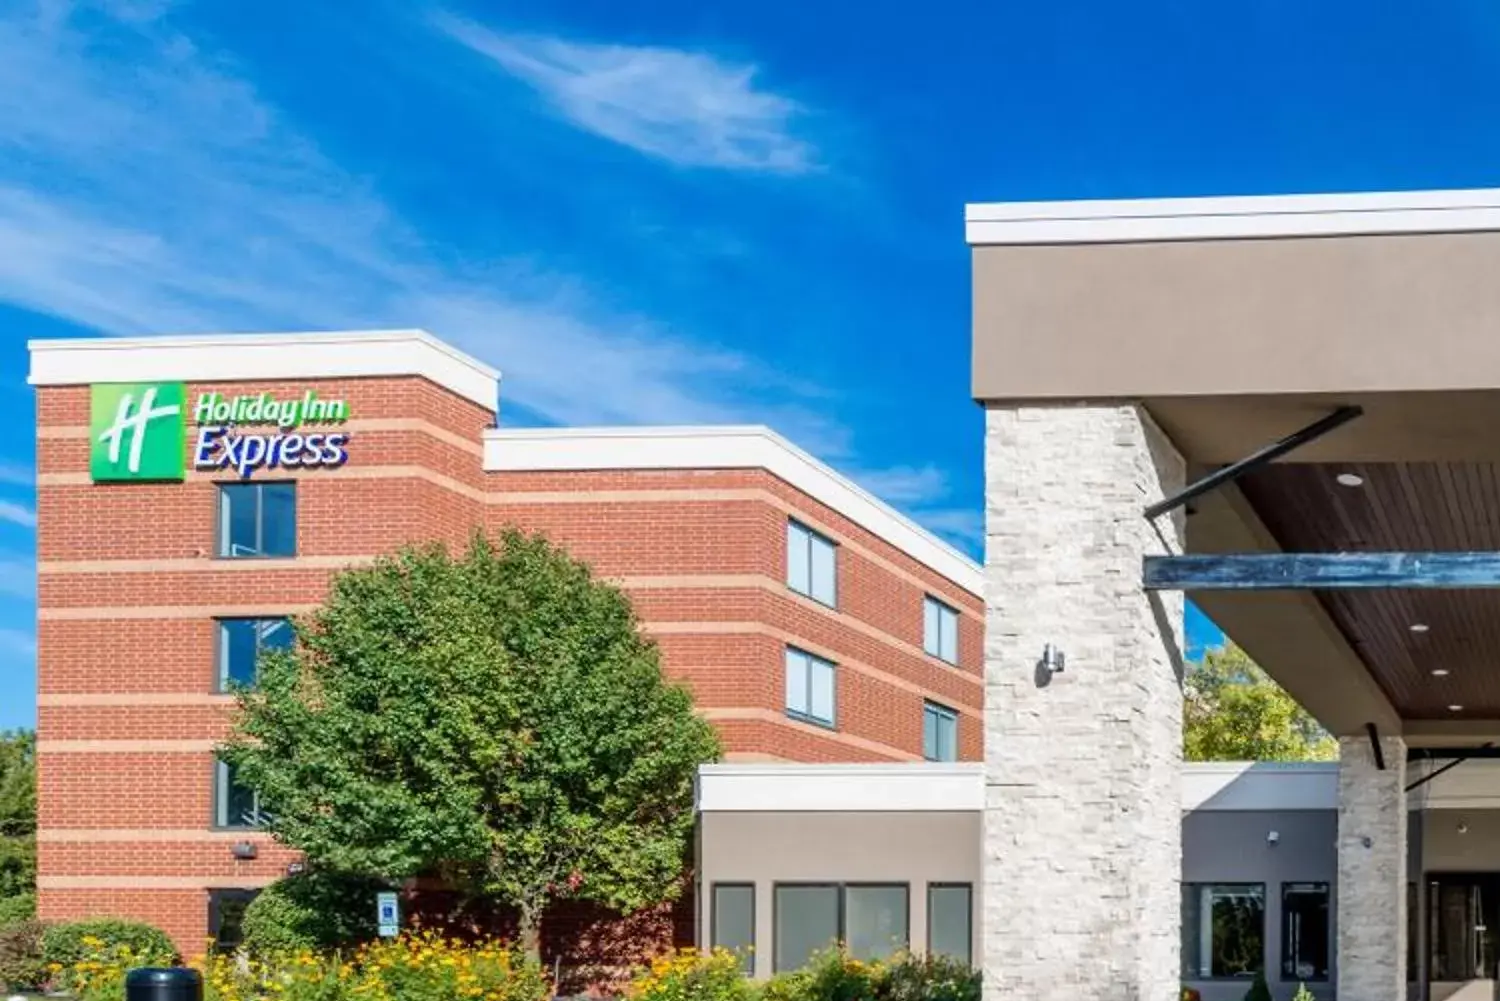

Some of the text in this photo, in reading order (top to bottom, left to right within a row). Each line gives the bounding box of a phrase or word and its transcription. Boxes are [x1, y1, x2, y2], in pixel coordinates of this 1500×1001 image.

[194, 390, 349, 428] Holiday Inn
[194, 426, 349, 478] Express
